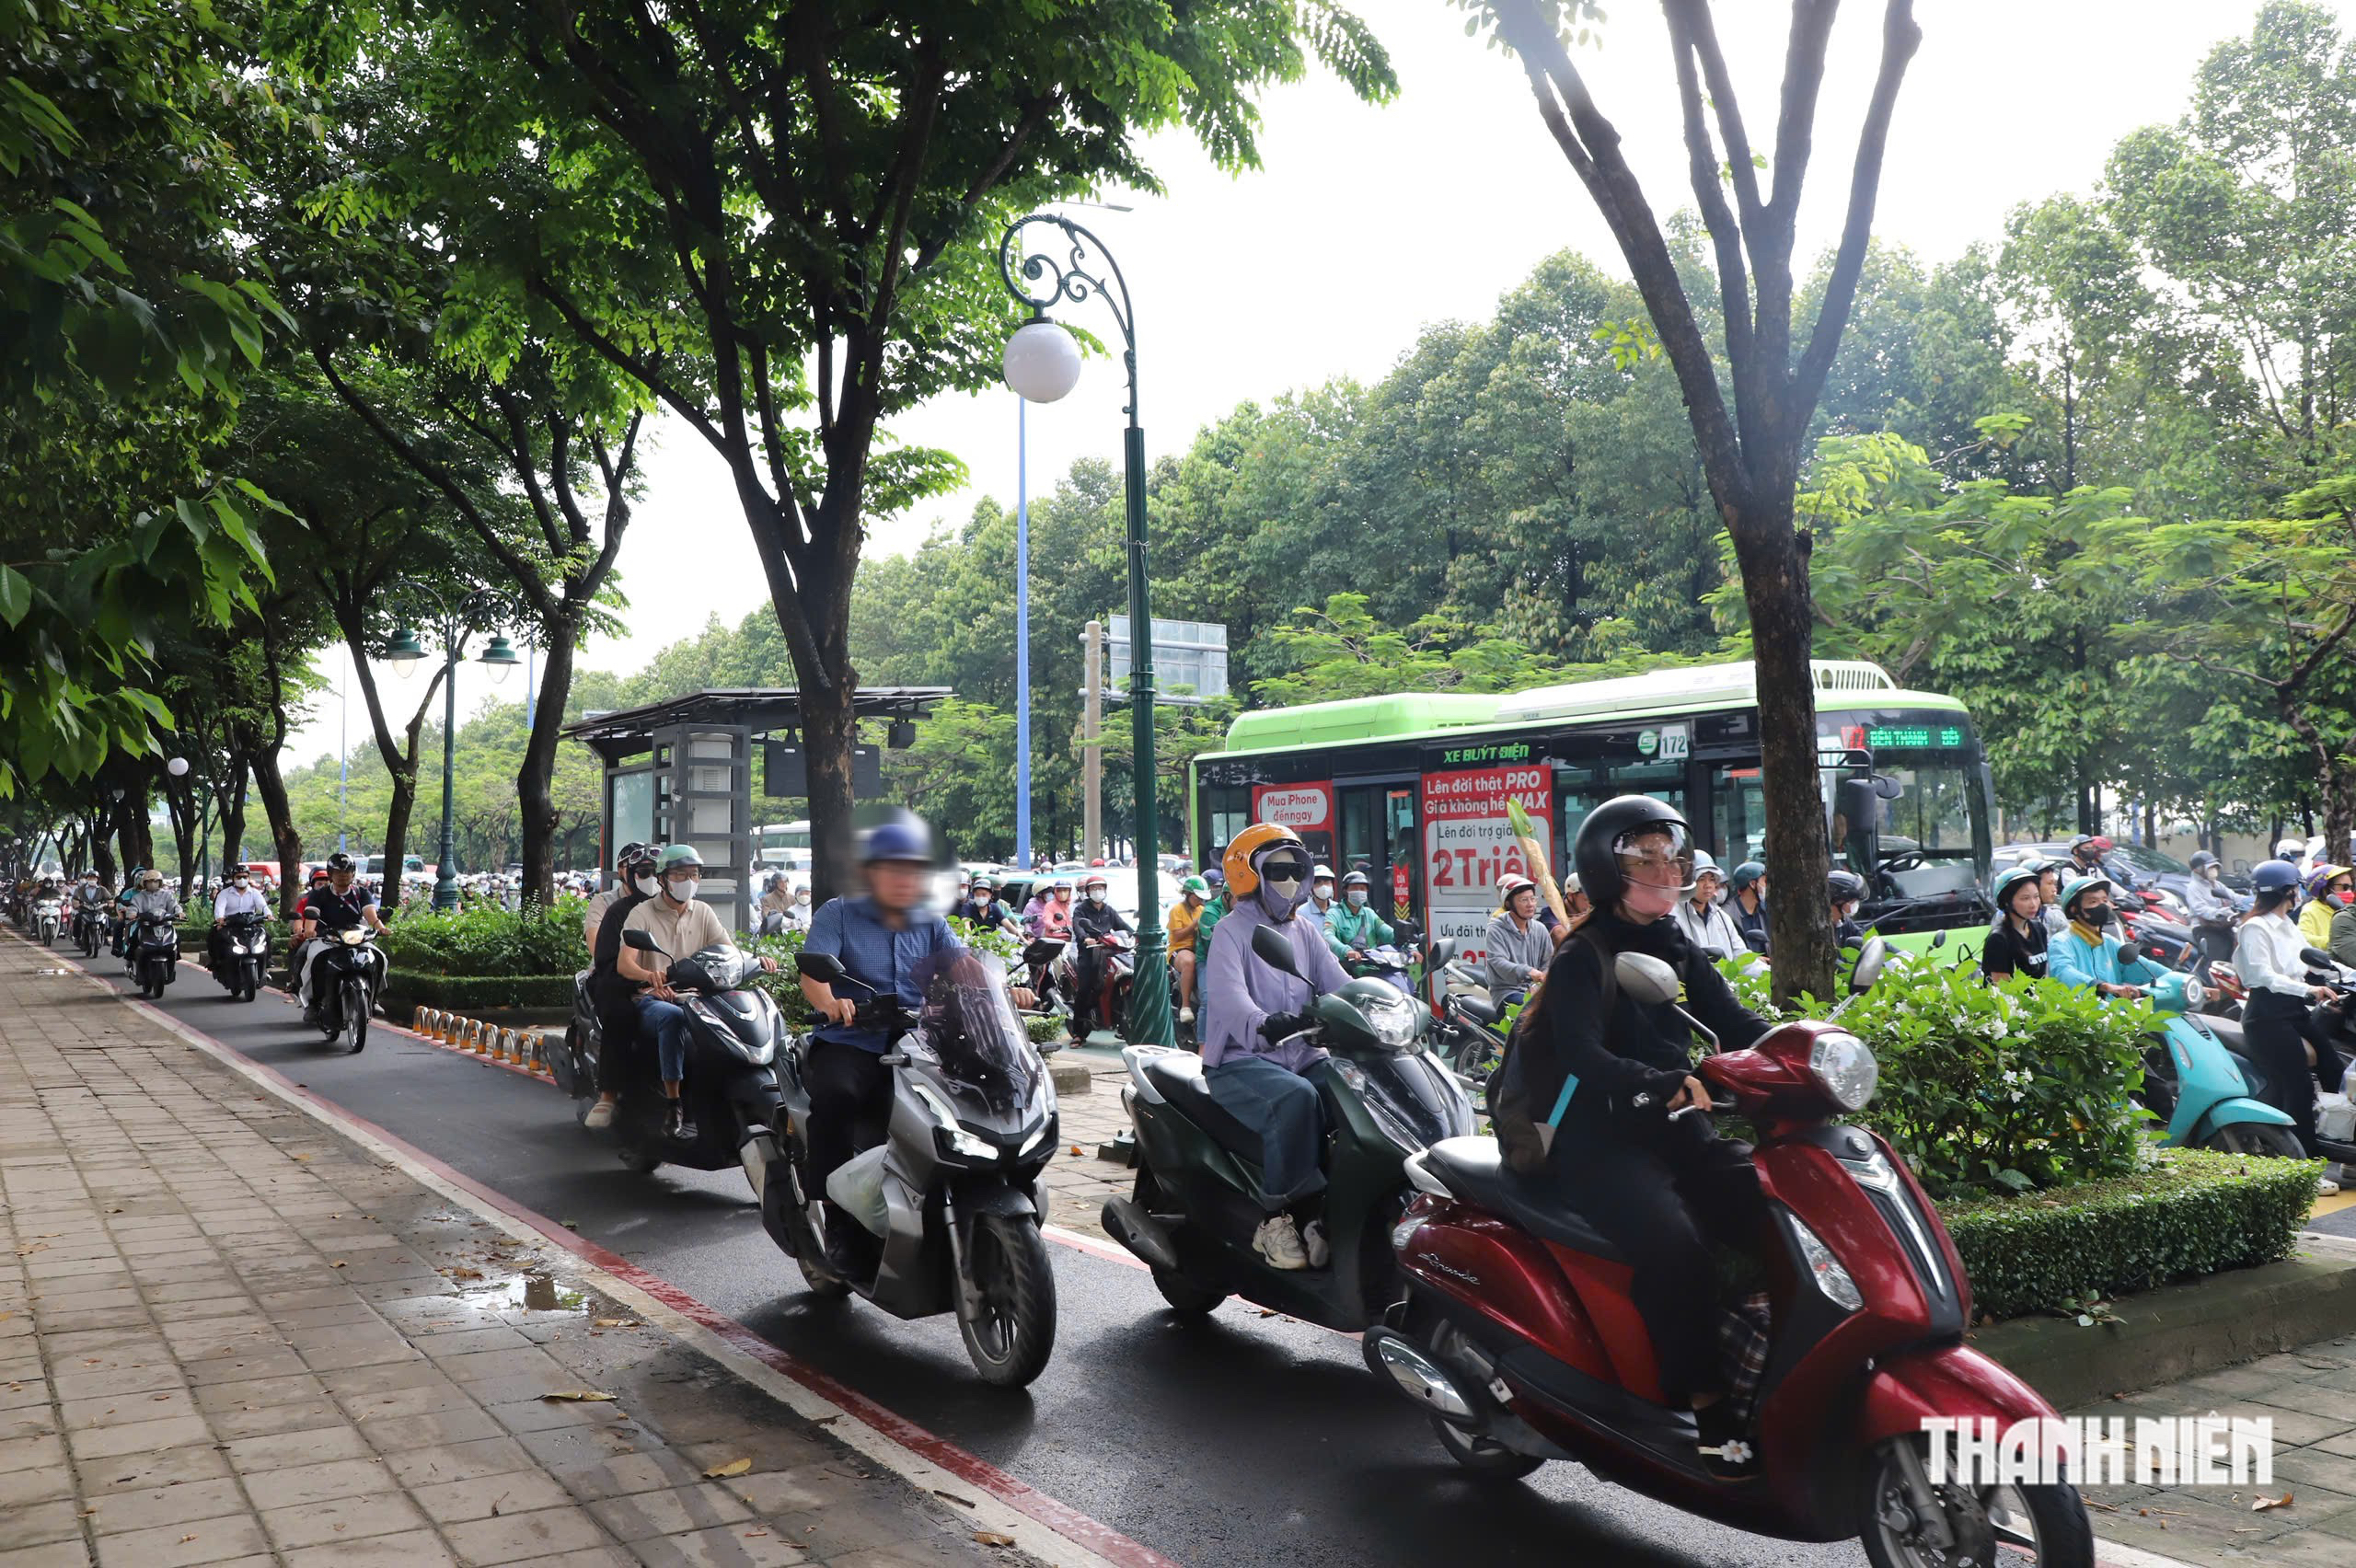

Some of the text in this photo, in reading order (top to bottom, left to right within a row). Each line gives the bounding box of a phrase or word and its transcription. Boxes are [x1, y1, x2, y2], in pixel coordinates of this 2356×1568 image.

[1443, 750, 1461, 763] XE
[1462, 744, 1497, 761] BUÝT
[1662, 735, 1686, 754] 172
[1426, 770, 1541, 795] Lên đời thật PRO
[1267, 796, 1287, 807] Mua
[1425, 797, 1448, 814] Giá
[1449, 798, 1488, 815] không
[1489, 792, 1506, 811] hề
[1273, 809, 1312, 824] đến ngay
[1438, 823, 1513, 840] Lên đời trợ giá
[1440, 924, 1454, 937] Ưu
[1456, 925, 1473, 938] đãi
